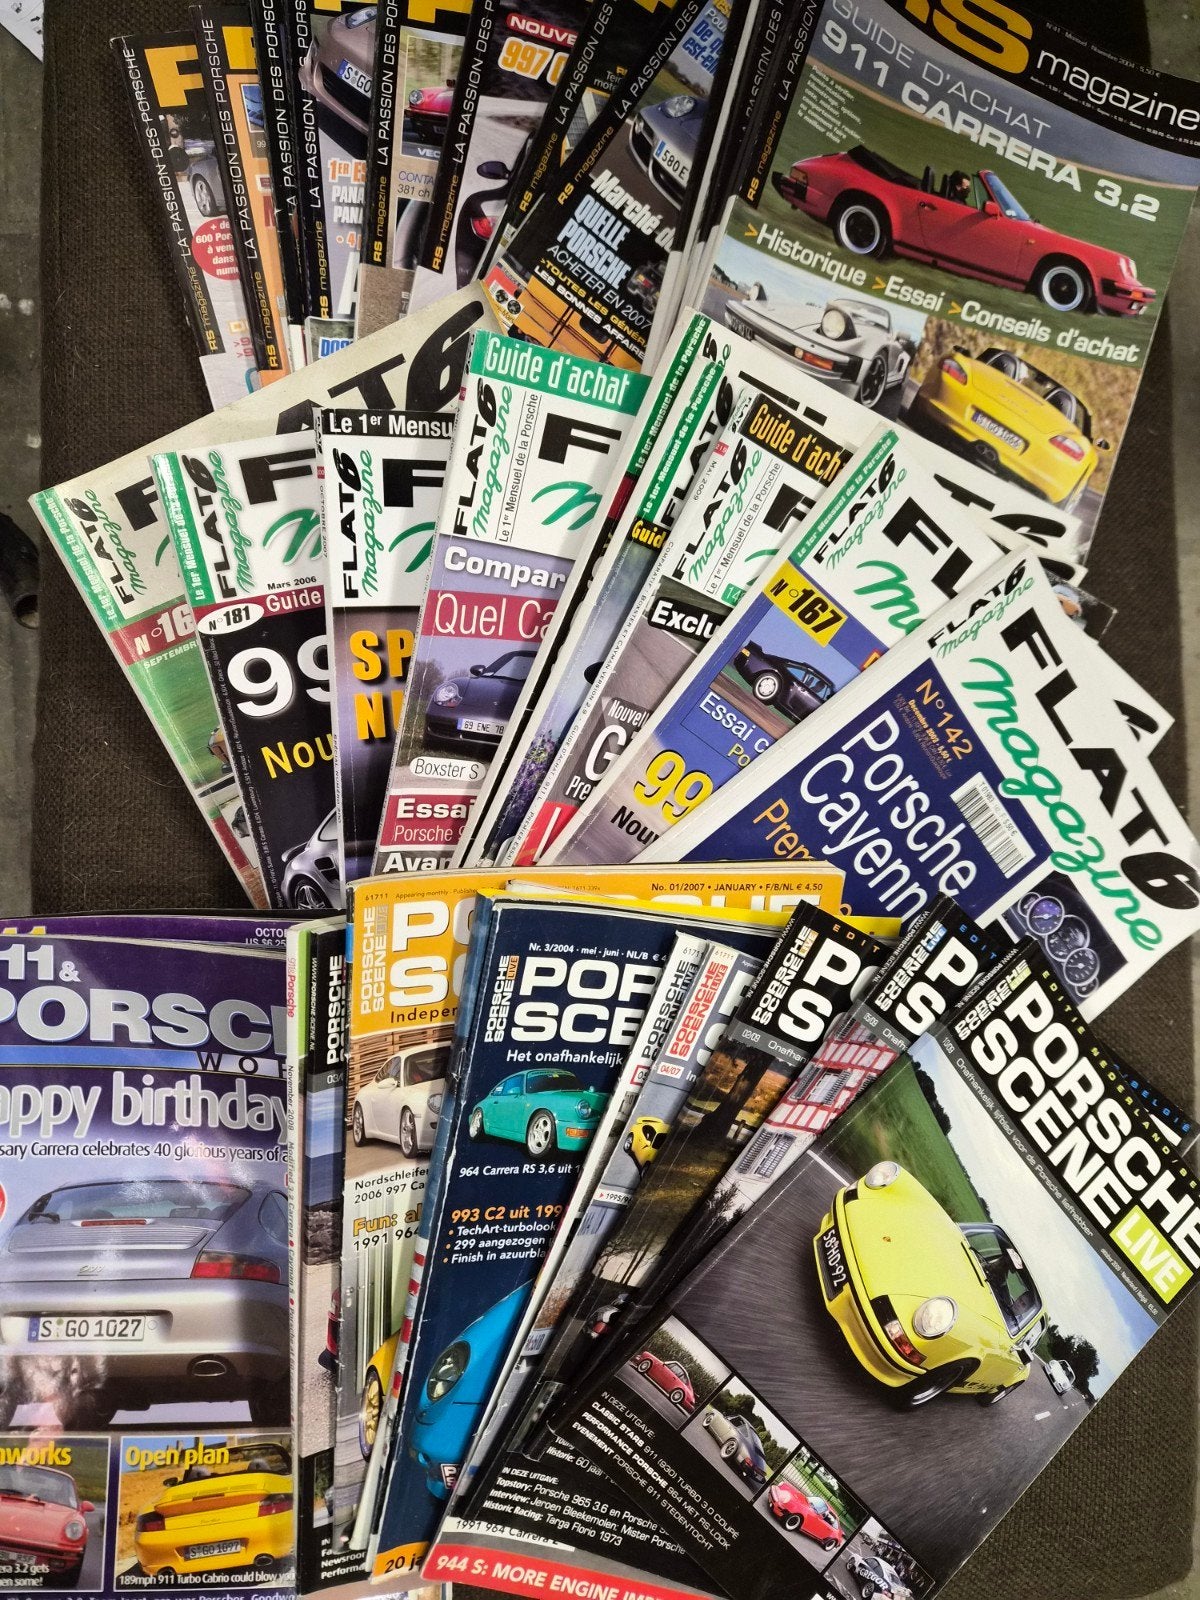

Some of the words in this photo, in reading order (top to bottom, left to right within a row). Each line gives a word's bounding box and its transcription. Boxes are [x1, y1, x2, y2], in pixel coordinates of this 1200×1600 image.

[201, 18, 227, 104] PORSCHE
[383, 33, 397, 66] DES
[476, 17, 494, 54] DES
[614, 98, 633, 120] LA
[629, 31, 678, 98] PASSION
[673, 1, 699, 31] DES
[832, 0, 916, 69] GUIDE
[921, 60, 1052, 139] D'ACHAT
[121, 48, 151, 122] PORSCHE
[269, 65, 286, 102] DES
[378, 70, 394, 141] PASSION
[458, 58, 485, 137] PASSION
[1036, 49, 1200, 131] magazine
[144, 124, 163, 166] DES
[219, 105, 237, 146] DES
[275, 108, 295, 188] PASSION
[376, 145, 390, 166] LA
[453, 139, 467, 164] LA
[747, 177, 760, 201] RS
[757, 110, 782, 176] magazine
[821, 20, 890, 88] 911
[901, 80, 1083, 193] CARRERA
[1093, 178, 1161, 223] 3.2
[154, 164, 182, 235] PASSION
[226, 150, 253, 231] PASSION
[373, 175, 388, 236] magazine
[572, 194, 631, 252] QUELLE
[590, 168, 661, 238] Marché
[176, 235, 191, 257] LA
[195, 233, 214, 244] 600
[243, 238, 258, 260] LA
[373, 241, 384, 263] RS
[556, 221, 632, 292] PORSCHE
[254, 271, 274, 339] magazine
[546, 245, 603, 294] ACHETER
[603, 285, 622, 307] EN
[619, 298, 652, 331] 2007
[756, 223, 867, 288] Historique
[884, 275, 946, 312] Essai
[960, 299, 1052, 344] Conseils
[1056, 327, 1142, 364] d'achat
[206, 329, 219, 351] RS
[265, 344, 279, 369] RS
[485, 336, 541, 383] Guide
[548, 355, 631, 407] d'achat
[452, 377, 498, 536] FLAT6
[472, 385, 513, 538] magazine
[84, 488, 148, 596] magazine
[181, 453, 238, 599] FLAT6
[208, 449, 256, 594] magazine
[332, 448, 362, 599] FLAT6
[671, 438, 748, 581] FLAT6
[688, 449, 763, 584] magazine
[812, 452, 896, 564] FLAT6
[63, 496, 135, 605] FLAT6
[266, 579, 292, 591] Mars
[294, 575, 317, 587] 2006
[265, 588, 322, 614] Guide
[433, 592, 507, 636] Quel
[926, 558, 1027, 650] FLAT6
[936, 576, 1035, 659] magazine
[698, 692, 756, 744] Essai
[413, 758, 466, 779] Boxster
[468, 762, 479, 780] S
[998, 606, 1200, 910] FLAT6
[394, 824, 454, 843] Porsche
[841, 709, 978, 896] Porsche
[960, 657, 1163, 952] magazine
[59, 960, 82, 982] &
[286, 974, 296, 1019] Porsche
[484, 954, 510, 1043] PORSCHE
[751, 925, 812, 1023] PORSCHE
[874, 920, 944, 1009] PORSCHE
[954, 958, 1029, 1033] PORSCHE
[0, 985, 287, 1057] ORSC
[641, 959, 690, 1059] PORSCHE
[669, 960, 720, 1056] PORSCHE
[287, 1064, 296, 1108] November
[659, 1063, 681, 1076] 04/07
[31, 1141, 81, 1157] Carrera
[82, 1140, 151, 1158] celebrates
[153, 1142, 172, 1158] 40
[229, 1146, 264, 1162] years
[266, 1145, 280, 1161] of
[955, 1057, 996, 1112] Onafhankelijk
[993, 1108, 1015, 1136] lijfblad
[1012, 1133, 1029, 1154] voor
[1026, 1153, 1038, 1166] de
[1034, 1164, 1063, 1200] Porsche
[1061, 1196, 1095, 1238] liefhebber
[969, 1017, 1134, 1230] SCENE
[1115, 1211, 1185, 1296] LIVE
[1003, 979, 1200, 1270] PORSCHE
[459, 1166, 480, 1178] 964
[482, 1164, 520, 1176] Carrera
[522, 1163, 536, 1174] RS
[538, 1164, 555, 1175] 3,6
[557, 1163, 573, 1174] uit
[451, 1209, 480, 1223] 993
[484, 1206, 505, 1221] C2
[509, 1205, 530, 1219] uit
[453, 1238, 476, 1250] 299
[478, 1236, 546, 1250] aangezogen
[456, 1221, 557, 1236] TechArt-turbolook
[40, 1319, 53, 1338] S
[65, 1318, 90, 1338] GO
[95, 1318, 142, 1337] 1027
[125, 1445, 181, 1472] Open
[184, 1443, 230, 1472] plan
[571, 1421, 615, 1457] EVENEMENT
[612, 1452, 648, 1488] PORSCHE
[646, 1485, 662, 1502] 911
[658, 1499, 715, 1551] STEDENTOCHT
[581, 1411, 634, 1456] PERFORMANCE
[631, 1452, 669, 1489] PORSCHE
[666, 1486, 684, 1504] 964
[681, 1500, 700, 1519] MET
[697, 1516, 732, 1551] RS-LOOK
[482, 1500, 515, 1516] Historic
[514, 1506, 544, 1523] Racing:
[545, 1513, 570, 1532] Targa
[571, 1519, 598, 1538] Florio
[598, 1530, 623, 1547] 1973
[489, 1488, 531, 1505] Interview:
[530, 1496, 563, 1513] Jeroen
[564, 1504, 619, 1532] Bleekemolen:
[620, 1523, 649, 1540] Mister
[14, 1575, 44, 1587] some!
[15, 1562, 29, 1575] 3.2
[30, 1563, 50, 1577] gets
[119, 1574, 156, 1588] 189mph
[158, 1573, 175, 1585] 911
[177, 1573, 201, 1585] Turbo
[202, 1571, 230, 1585] Cabrio
[230, 1570, 254, 1583] could
[255, 1569, 277, 1582] blow
[384, 1555, 406, 1574] 20
[436, 1554, 468, 1574] 944
[470, 1558, 489, 1576] S:
[491, 1561, 546, 1589] MORE
[549, 1572, 620, 1600] ENGINE
[858, 1567, 889, 1592] GREGOR
